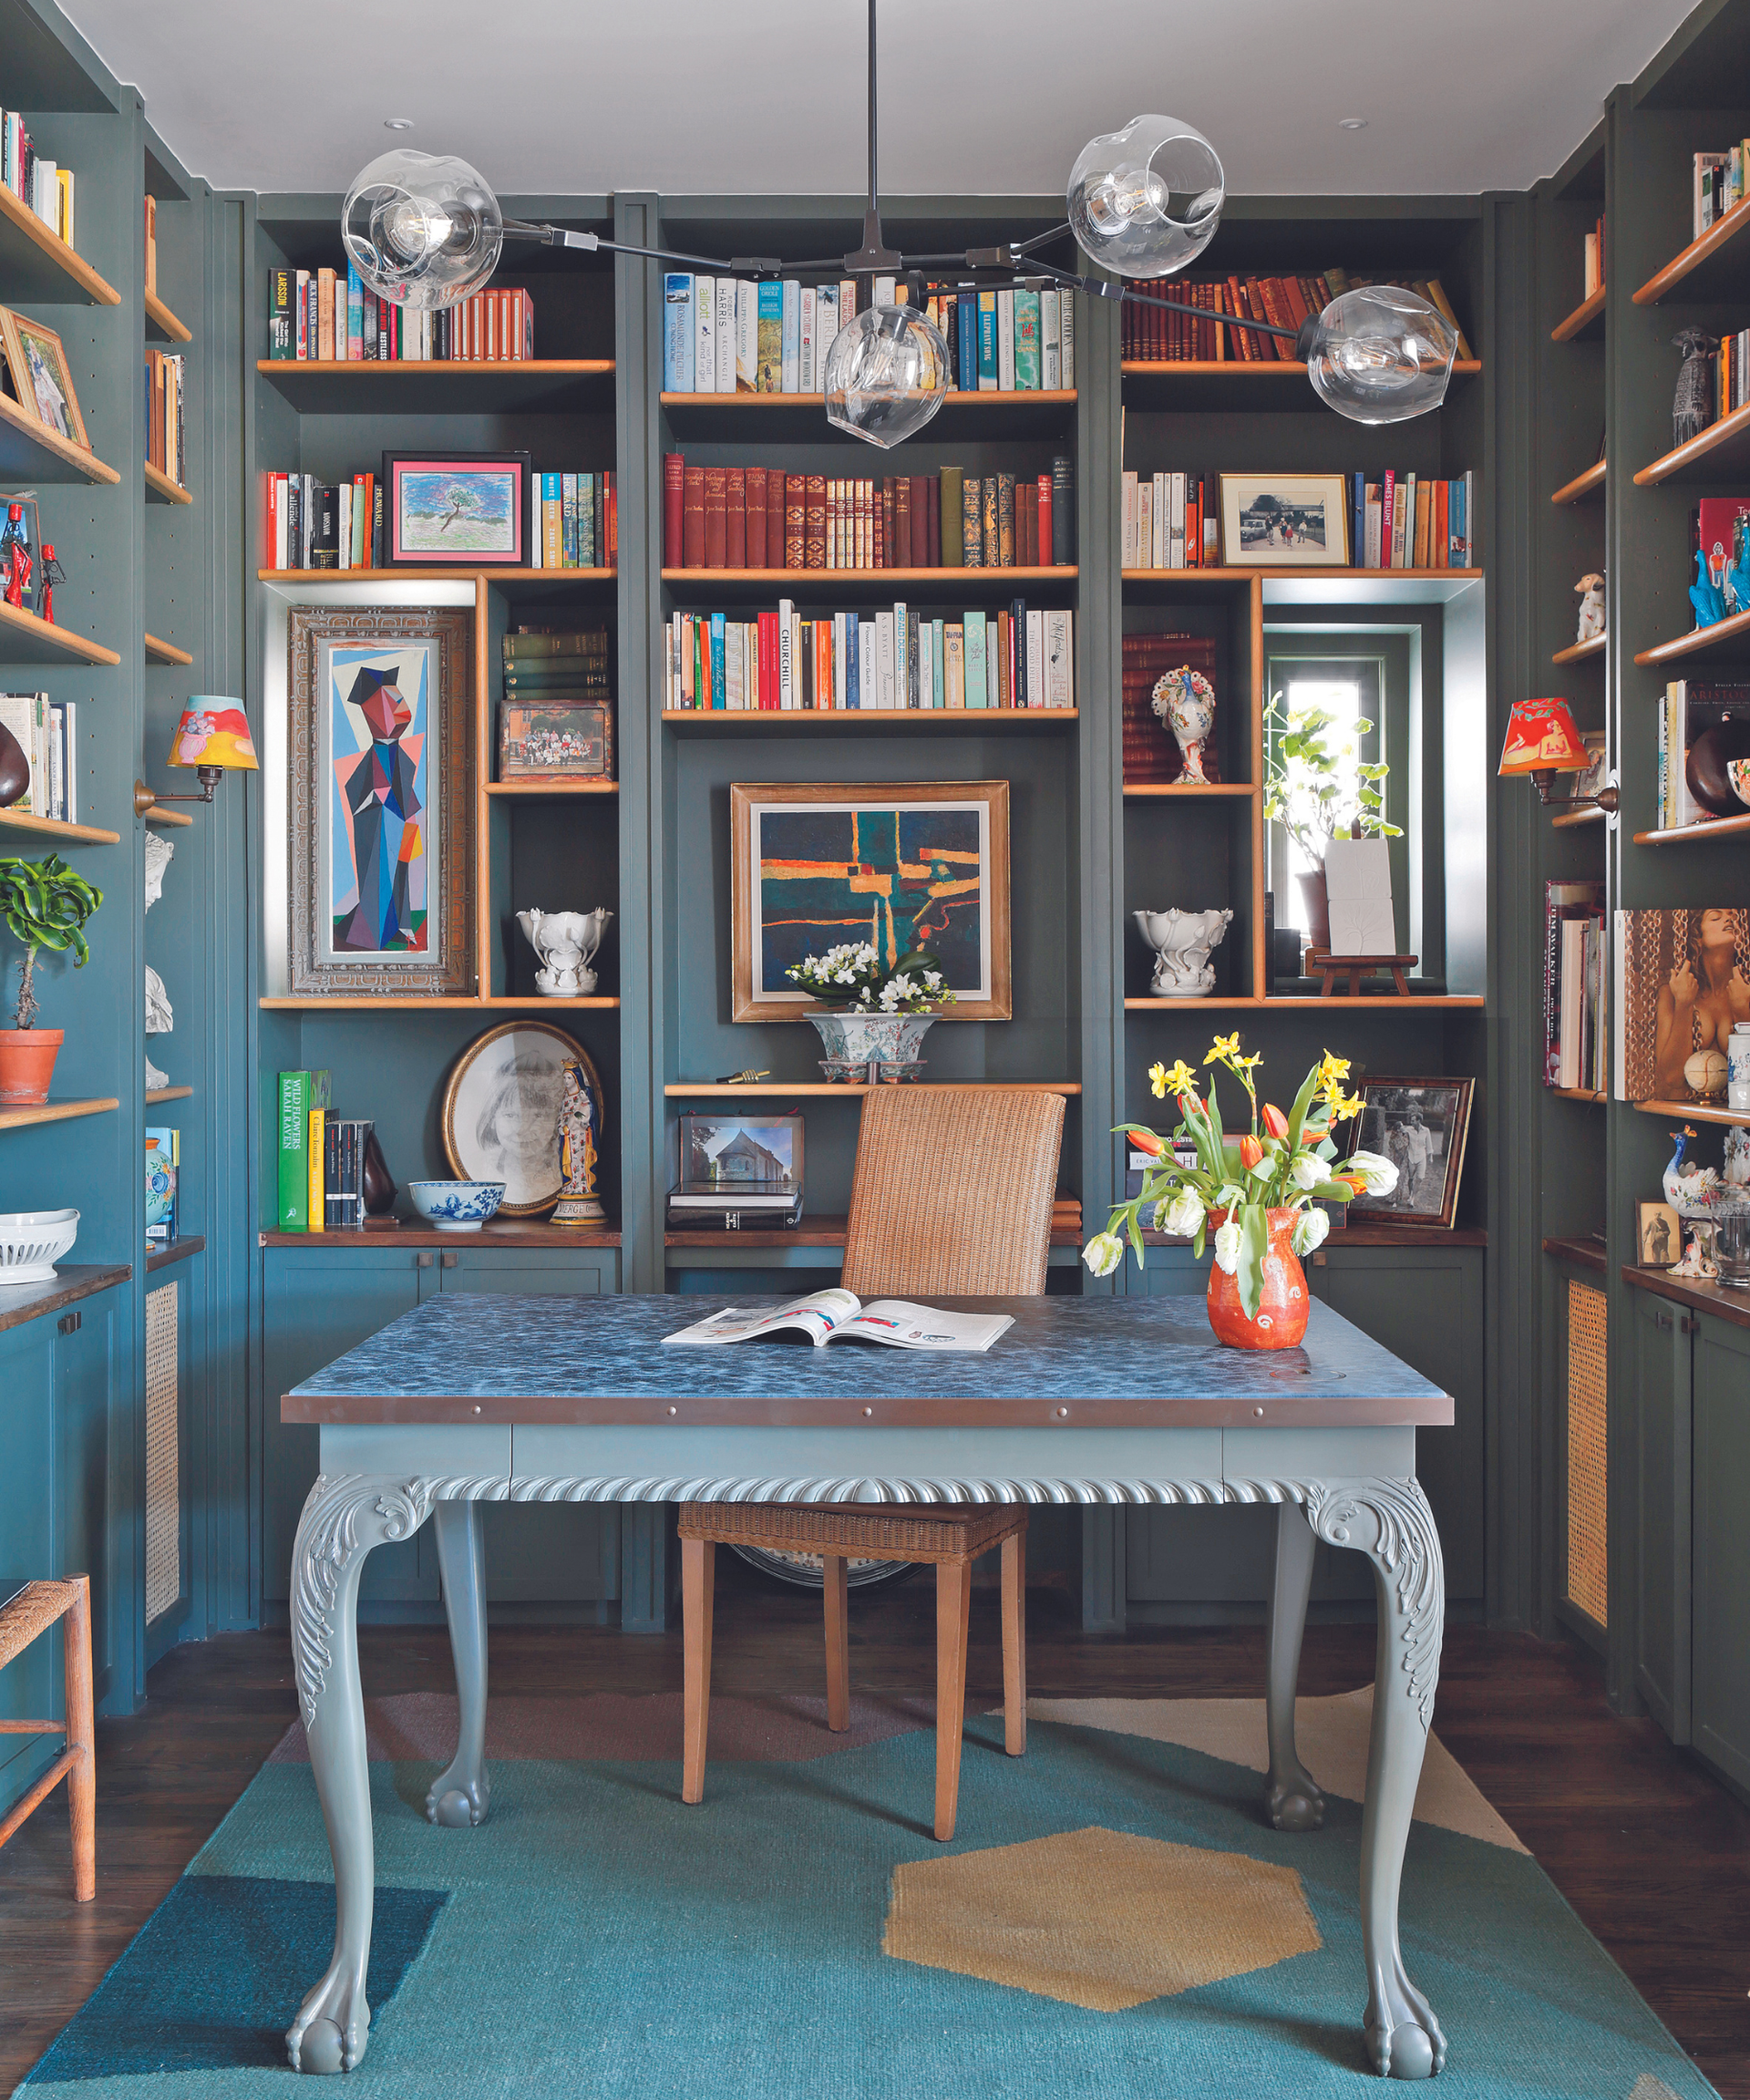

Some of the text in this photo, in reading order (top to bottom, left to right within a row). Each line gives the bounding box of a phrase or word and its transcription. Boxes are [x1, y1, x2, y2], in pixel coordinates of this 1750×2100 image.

[277, 272, 287, 306] LARSSON
[293, 1079, 301, 1149] WILD FLOWERS
